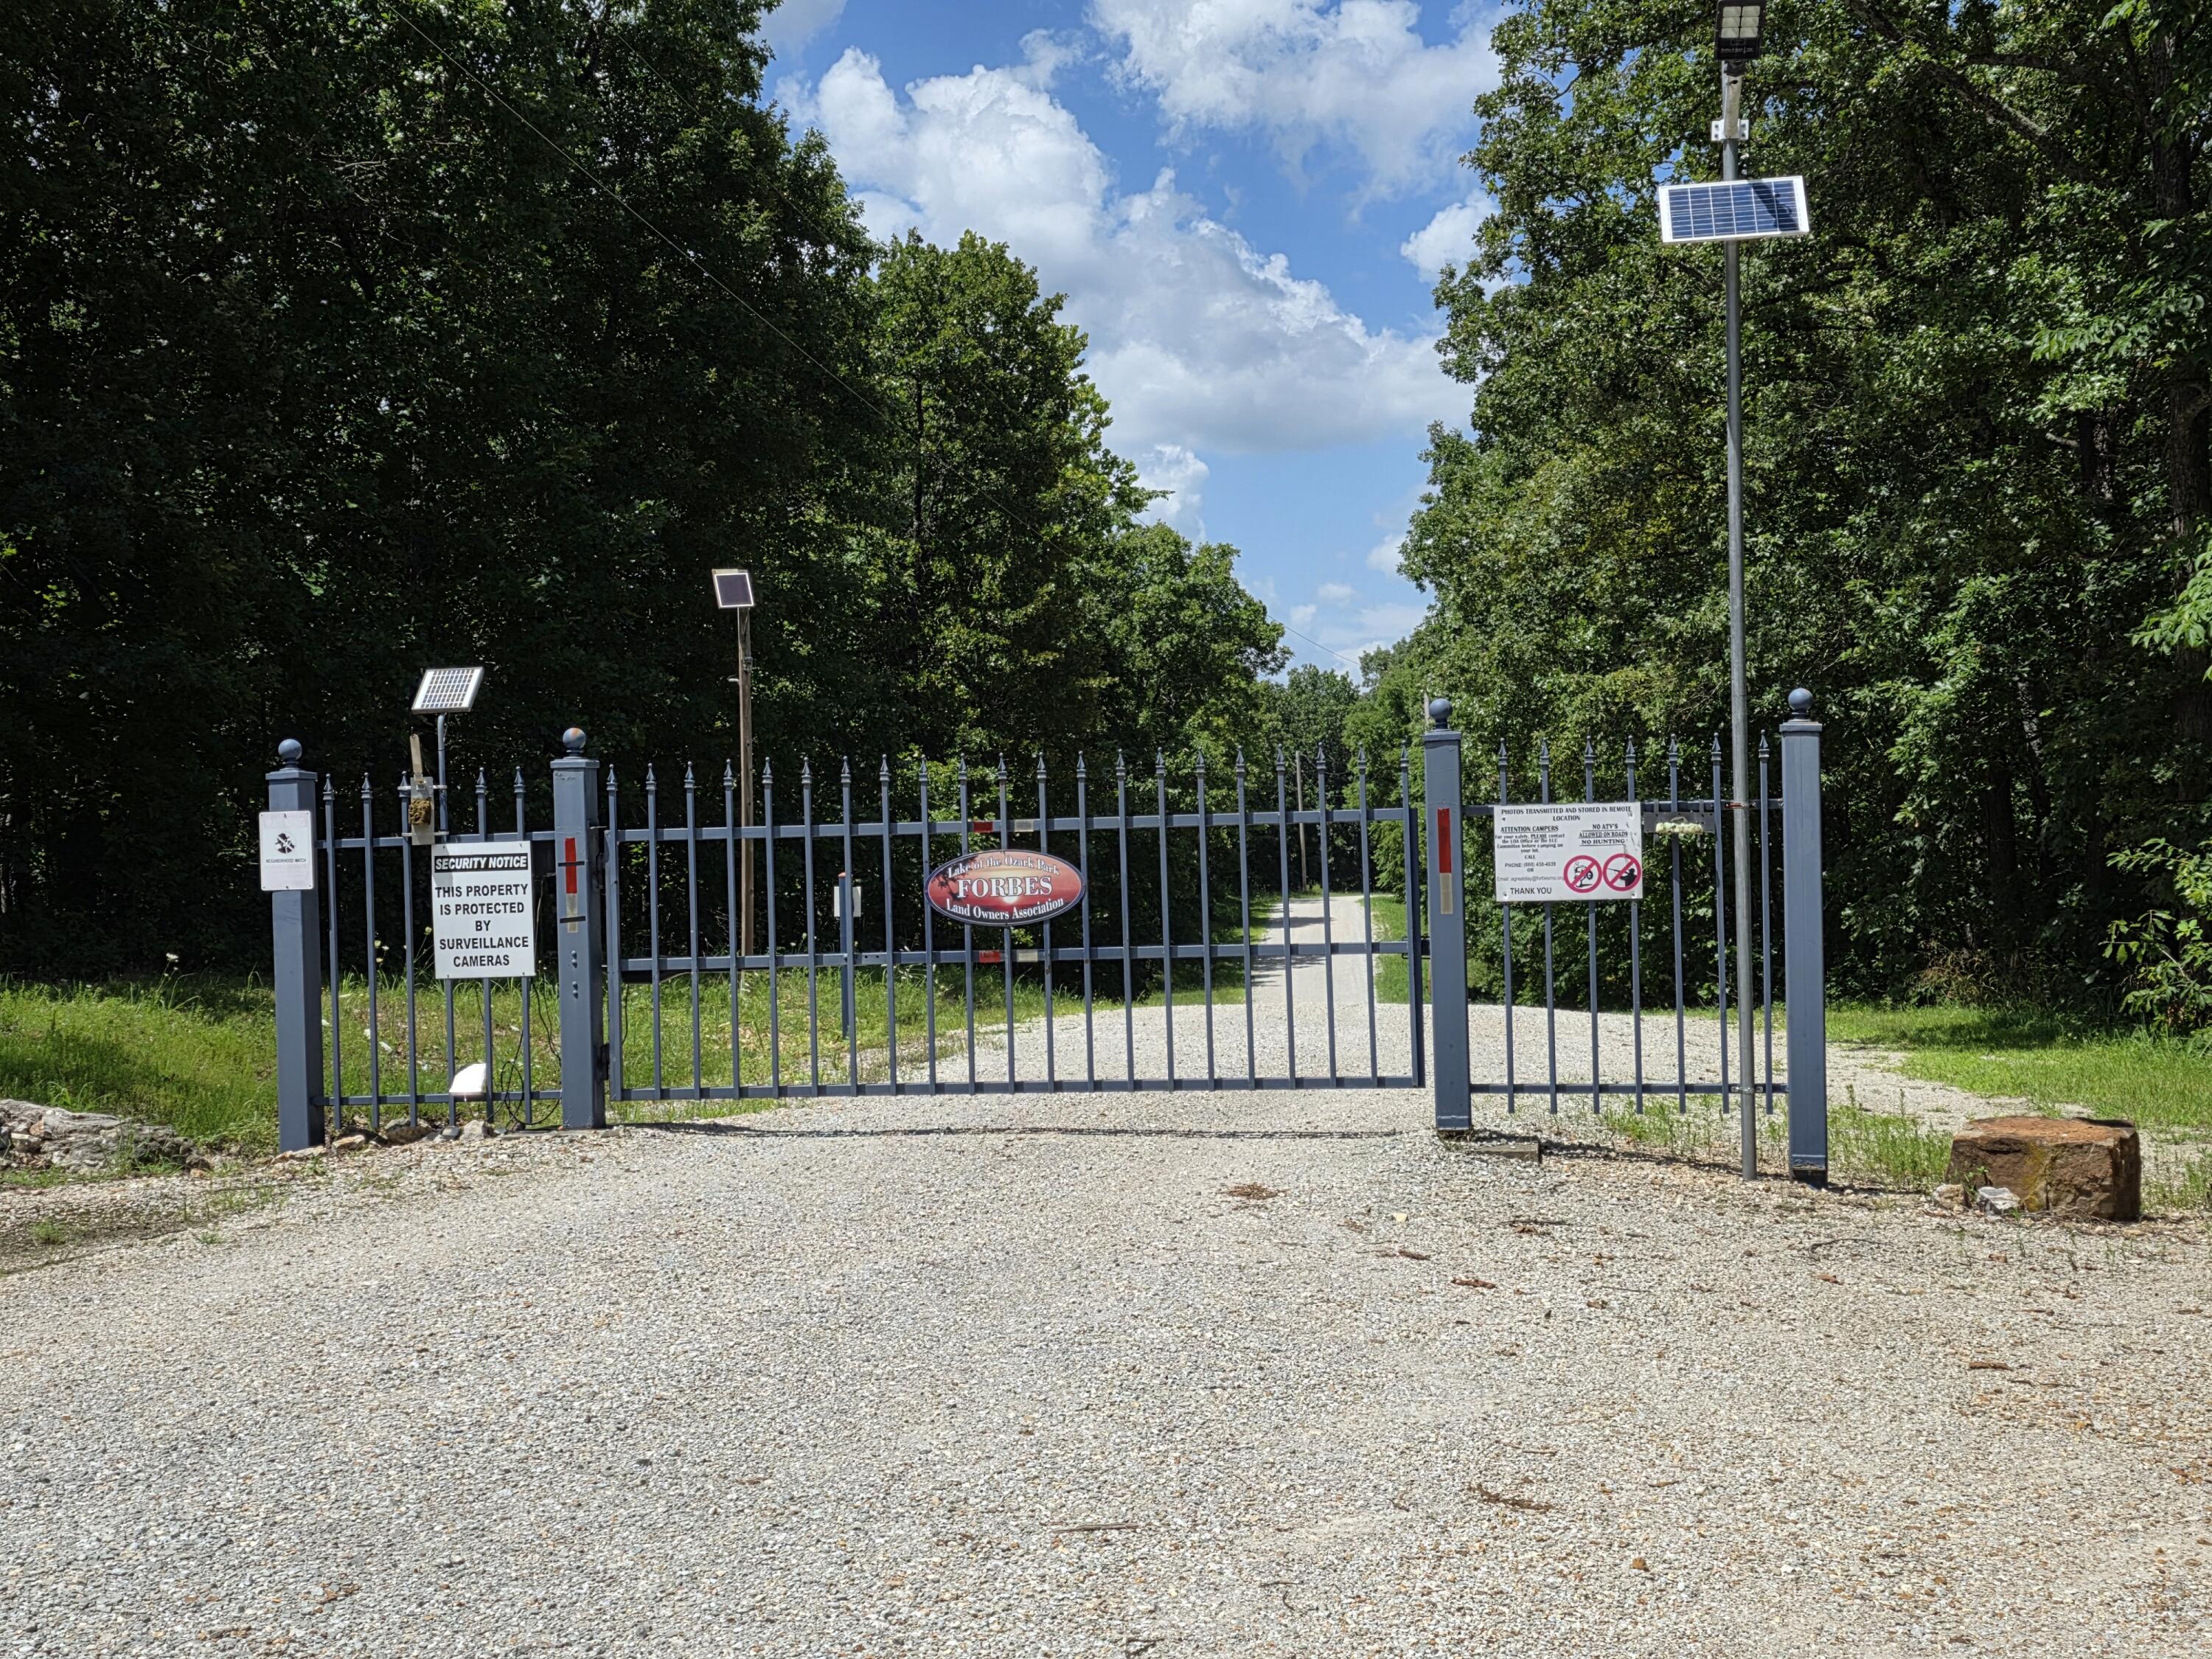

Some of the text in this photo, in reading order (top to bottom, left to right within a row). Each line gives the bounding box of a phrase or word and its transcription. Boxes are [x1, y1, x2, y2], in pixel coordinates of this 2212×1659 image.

[435, 855, 527, 870] SECURITY NOTICE
[947, 855, 1060, 878] Lake of the Ozark Park
[435, 884, 529, 898] THIS PROPERTY
[956, 875, 1053, 898] FORBES
[440, 902, 524, 915] IS PROTECTED
[945, 897, 1064, 920] Land Owners Association
[475, 920, 491, 931] BY
[439, 936, 529, 950] SURVEILLANCE
[453, 955, 509, 967] CAMERAS
